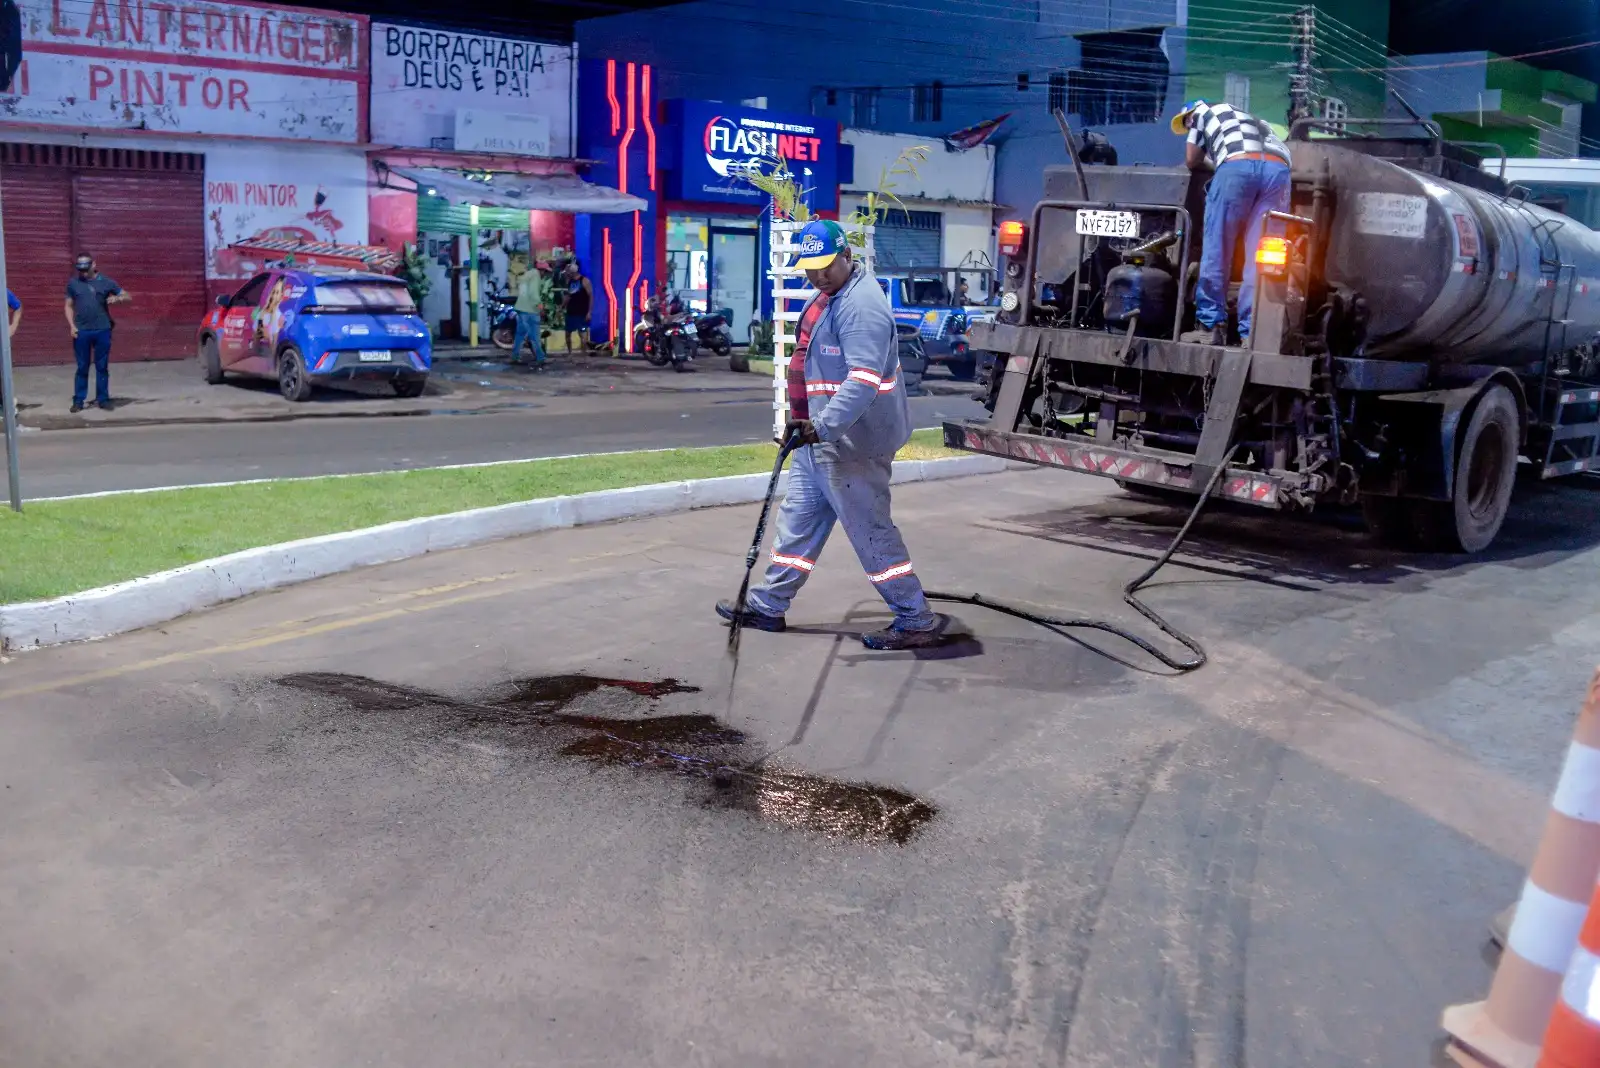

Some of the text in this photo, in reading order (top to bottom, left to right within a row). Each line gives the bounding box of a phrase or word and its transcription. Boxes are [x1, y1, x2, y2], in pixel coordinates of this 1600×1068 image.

[51, 0, 354, 66] LANTERNAGEM
[387, 26, 545, 74] BORRACHARIA
[88, 64, 251, 112] PINTOR
[404, 58, 463, 91] DEUS
[495, 69, 530, 97] PAI
[207, 181, 298, 207] RONI PINTOR
